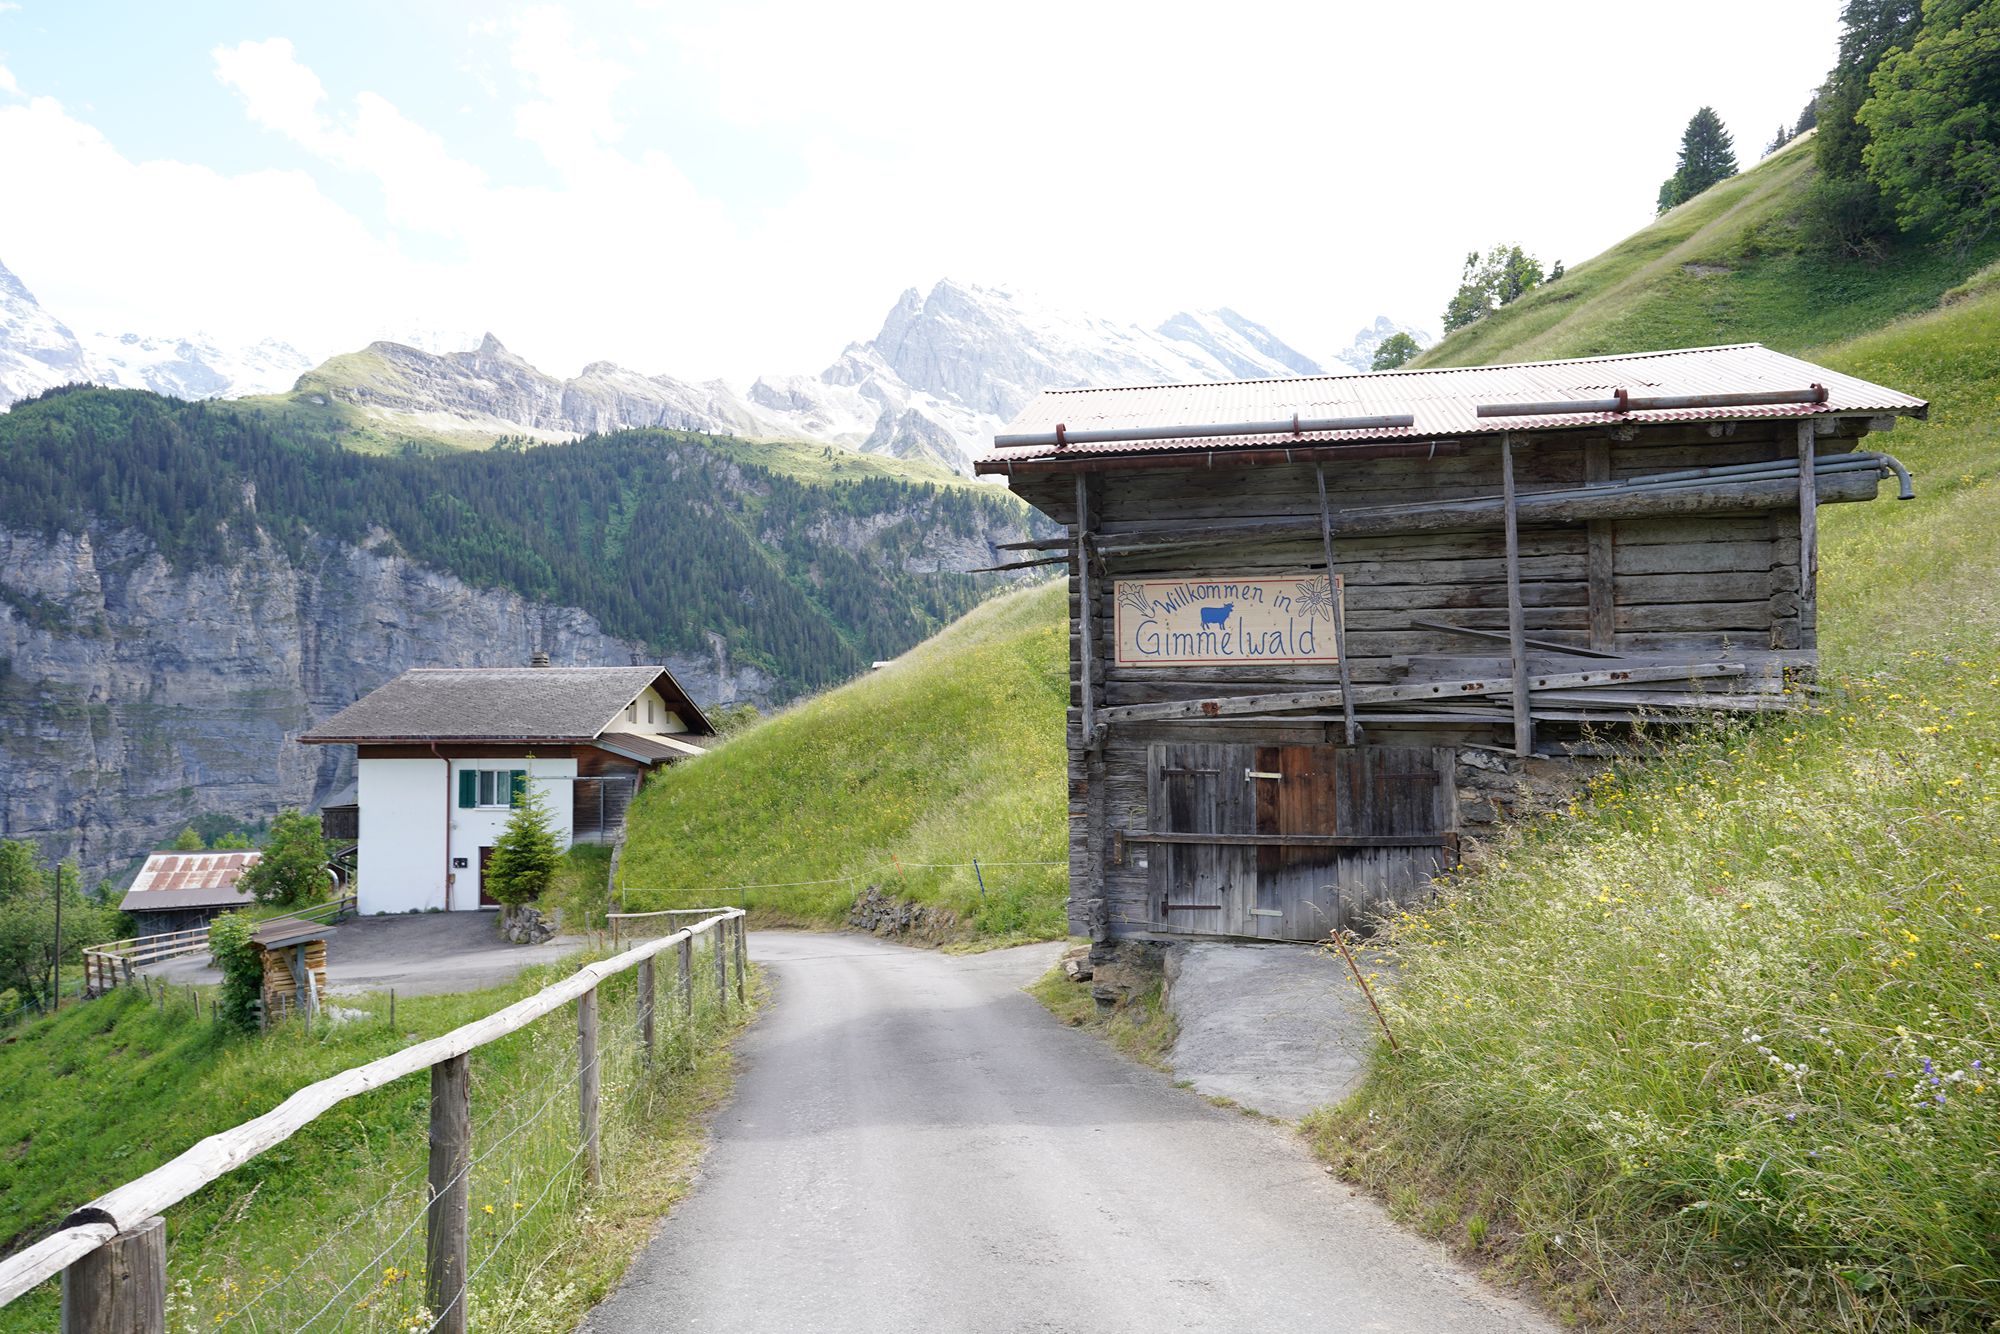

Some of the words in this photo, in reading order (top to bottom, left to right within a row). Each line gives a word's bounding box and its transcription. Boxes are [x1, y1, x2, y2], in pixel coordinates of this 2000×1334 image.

[1153, 583, 1264, 614] Willkommen
[1273, 591, 1292, 613] in
[1136, 616, 1316, 656] Gimmelwald
